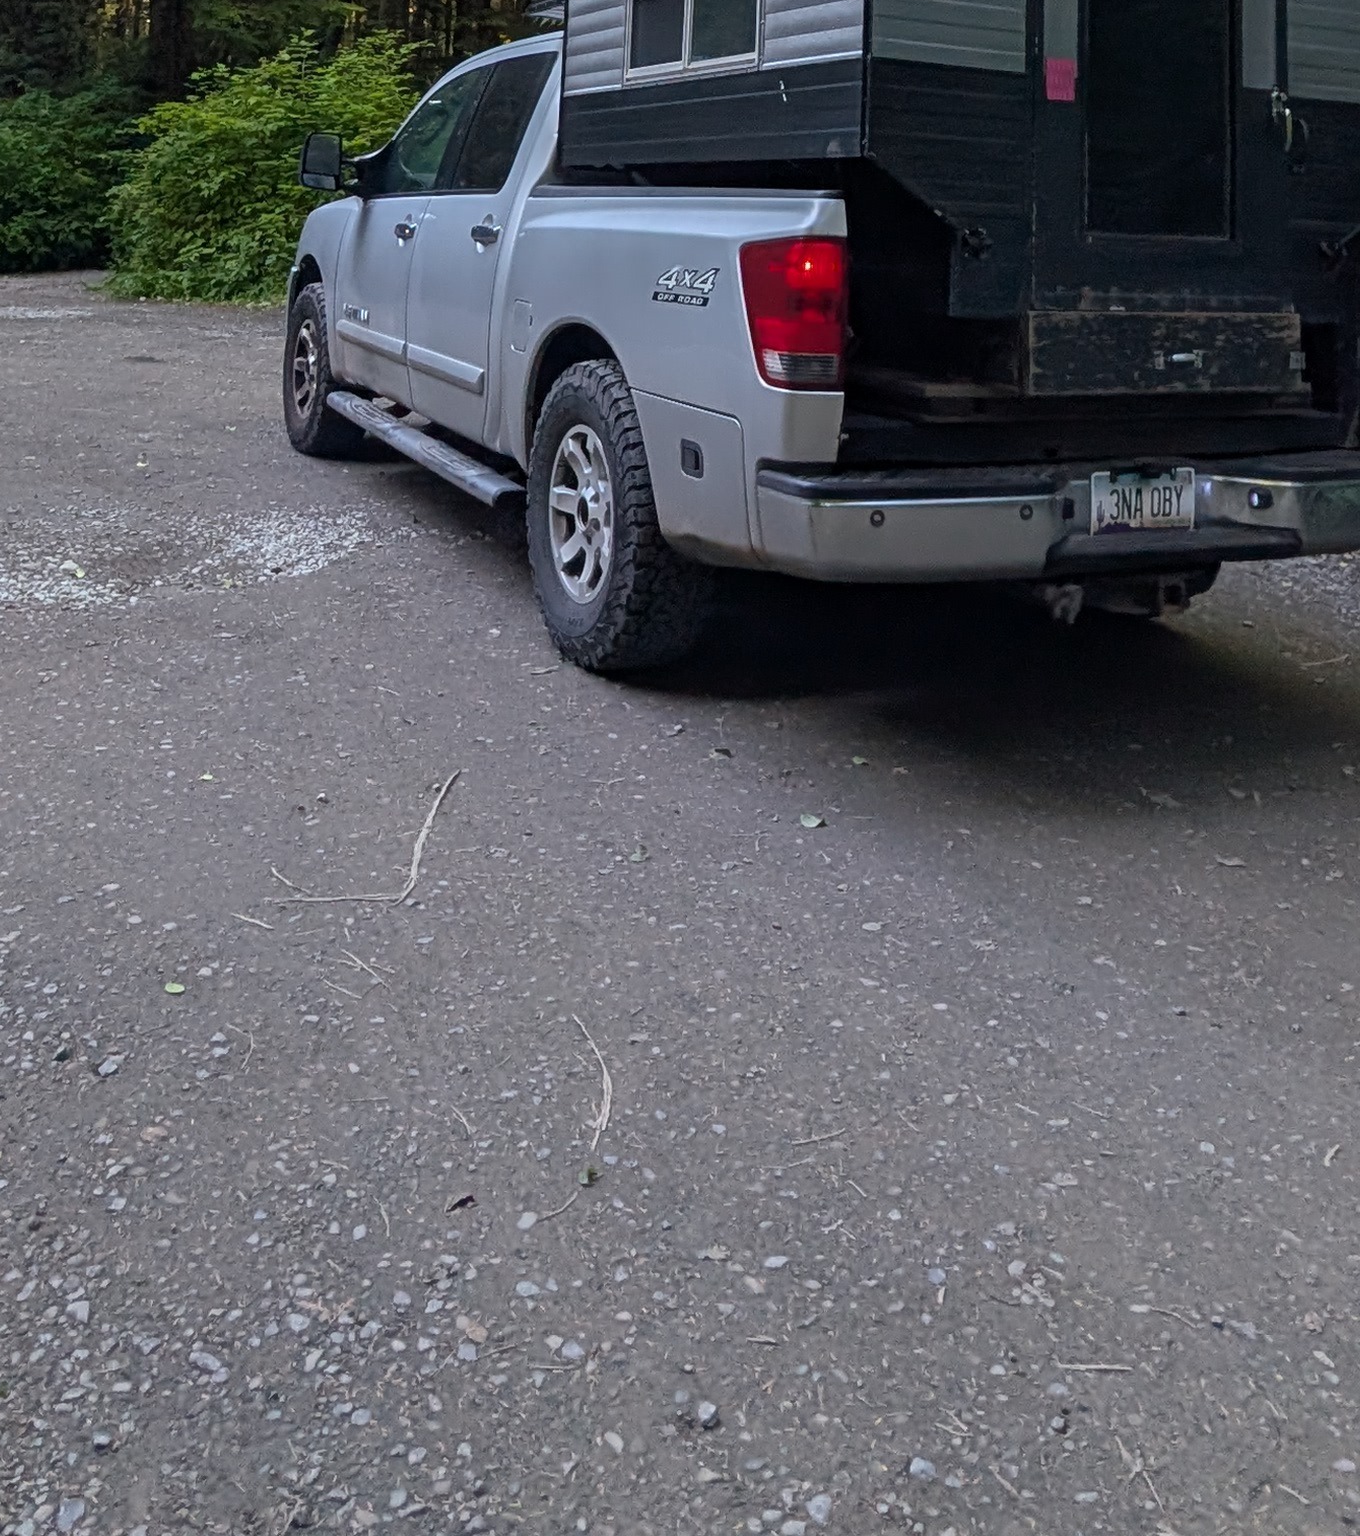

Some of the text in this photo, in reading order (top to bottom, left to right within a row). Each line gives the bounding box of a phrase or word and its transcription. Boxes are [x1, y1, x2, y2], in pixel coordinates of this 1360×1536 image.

[657, 293, 704, 305] OFF ROAD
[1109, 487, 1143, 521] 3NA
